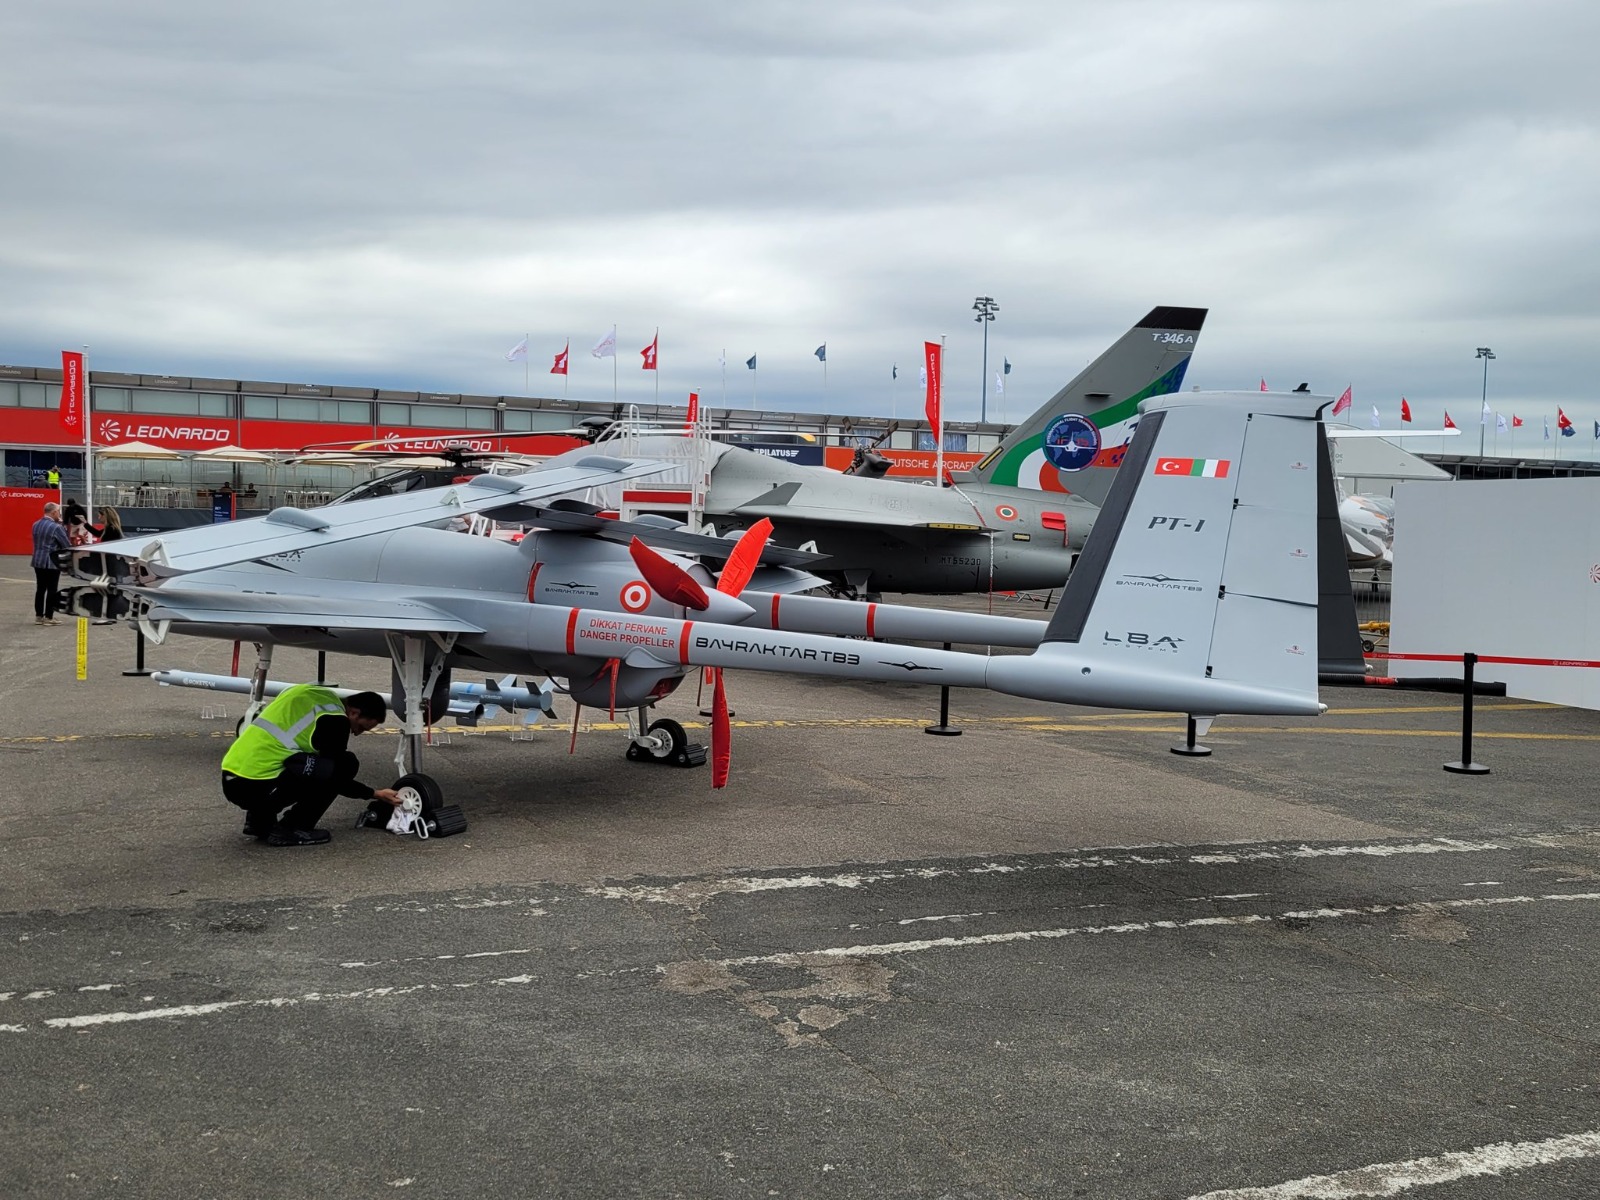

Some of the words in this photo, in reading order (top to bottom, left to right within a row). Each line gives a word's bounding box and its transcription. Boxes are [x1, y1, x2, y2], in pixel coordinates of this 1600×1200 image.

[125, 425, 230, 441] LEONARDO
[759, 448, 791, 457] PILATUS
[891, 458, 930, 469] EUTSCHE
[932, 460, 976, 470] ARCRAFT
[8, 491, 45, 499] LEONARDO
[544, 587, 585, 595] BAYRAKTAR
[1115, 581, 1181, 590] BAYRAKTAR
[590, 618, 623, 630] DİKKAT
[624, 623, 668, 636] PERVANE
[580, 629, 618, 642] DANGER
[620, 634, 675, 648] PROPELLER
[1104, 630, 1185, 649] LBA
[695, 637, 818, 660] BAYRAKTAR
[820, 650, 861, 666] TB3
